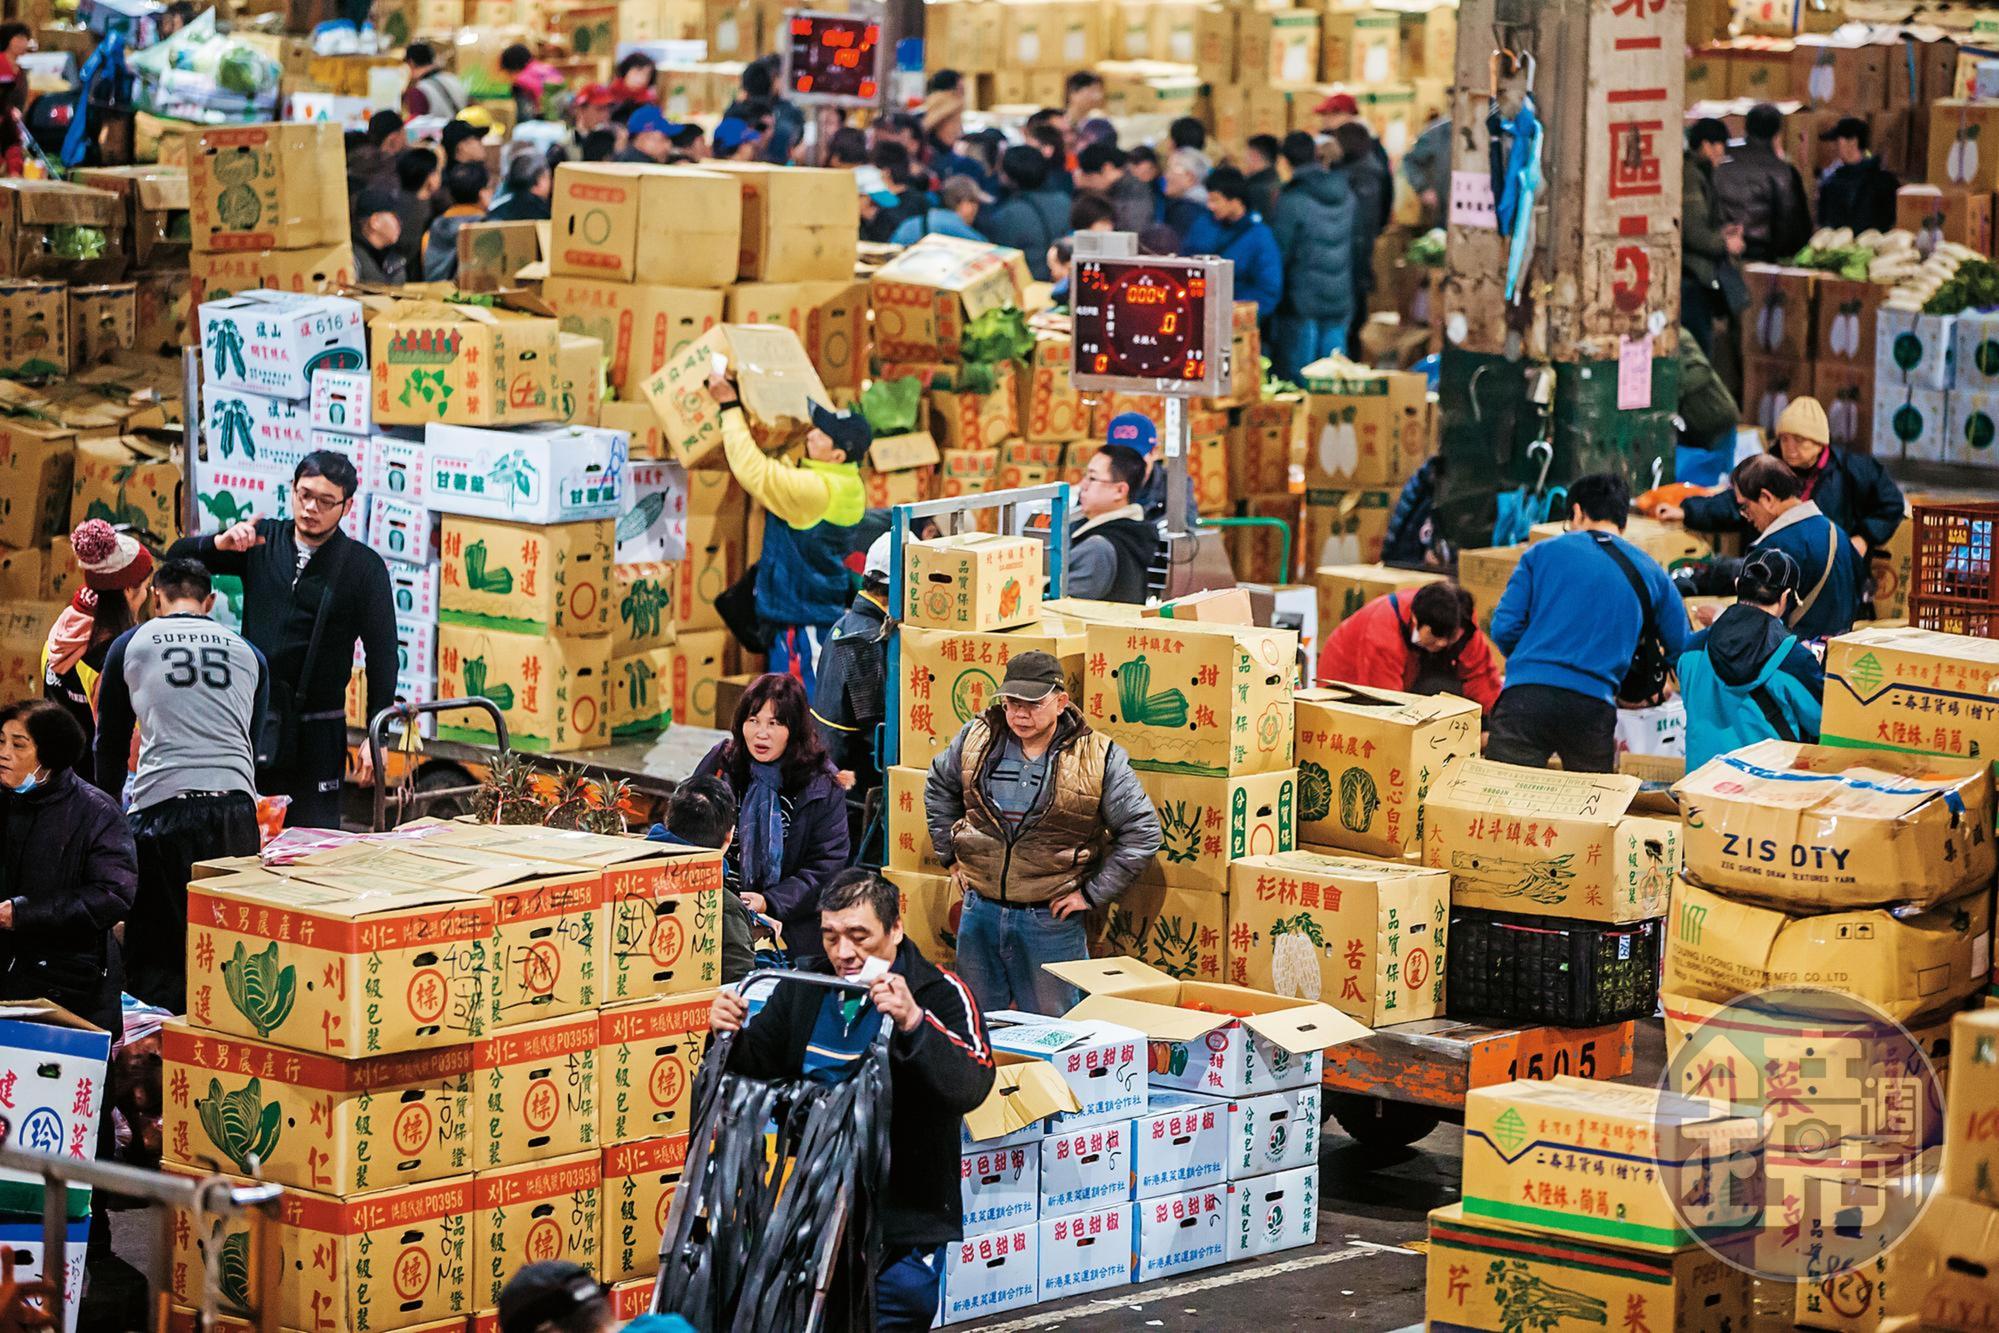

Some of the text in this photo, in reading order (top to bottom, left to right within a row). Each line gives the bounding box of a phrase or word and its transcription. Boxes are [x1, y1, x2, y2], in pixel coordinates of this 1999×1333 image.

[1126, 284, 1167, 304] 0004
[316, 315, 343, 336] 616
[443, 531, 462, 588] 甜椒
[520, 539, 541, 597] 特選
[908, 554, 922, 619] 分級包裝
[152, 633, 232, 647] SUPPORT
[160, 646, 233, 691] 35
[1127, 635, 1185, 655] 北斗鎮農會
[521, 655, 542, 713] 特選
[909, 664, 937, 736] 精緻
[1089, 652, 1108, 720] 特選
[1195, 664, 1220, 729] 甜椒
[1300, 730, 1376, 761] 田中鎮農會
[1203, 805, 1225, 860] 新鮮
[1386, 767, 1405, 845] 包心白菜
[1467, 817, 1559, 849] 北斗鎮農會
[1583, 843, 1605, 908] 芹菜
[1627, 834, 1640, 906] 分級包裝
[1721, 833, 1778, 863] ZIS
[614, 873, 647, 899] 刈仁
[1256, 874, 1343, 913] 杉林農會
[361, 924, 398, 947] 刈仁
[701, 889, 718, 982] 品質保證
[1198, 925, 1220, 978] 新鮮
[1230, 922, 1253, 988] 特選
[1432, 899, 1446, 1005] 分級包裝
[195, 932, 216, 1027] 特選
[1340, 938, 1367, 1004] 苦瓜
[321, 957, 346, 1051] 刈仁
[364, 952, 384, 1052] 分級包裝
[613, 1015, 646, 1041] 刈仁
[191, 1040, 302, 1083] 文男農產行
[485, 1039, 519, 1064] 刈仁
[1067, 1044, 1135, 1073] 彩色甜椒
[1208, 1053, 1225, 1089] 甜椒
[71, 1076, 94, 1162] 蔬菜
[170, 1068, 192, 1163] 特選
[488, 1066, 504, 1166] 分級包裝
[579, 1050, 595, 1144] 品質保證
[615, 1042, 630, 1139] 分級包裝
[307, 1094, 335, 1189] 刈仁
[355, 1089, 373, 1190] 分級包裝
[451, 1075, 469, 1169] 品質保證
[1056, 1129, 1120, 1161] 彩色甜椒
[1152, 1111, 1215, 1140] 彩色甜椒
[1242, 1105, 1255, 1169] 分級包裝
[616, 1149, 649, 1171] 刈仁
[352, 1205, 387, 1231] 刈仁
[488, 1178, 521, 1204] 刈仁
[1155, 1192, 1216, 1224] 彩色甜椒
[1240, 1187, 1252, 1250] 分級包裝
[620, 1175, 639, 1273] 分級包裝
[961, 1231, 1027, 1264] 彩色甜椒
[1054, 1211, 1120, 1242] 彩色甜椒
[310, 1238, 337, 1330] 刈仁
[355, 1232, 373, 1332] 分級包裝
[449, 1214, 466, 1312] 品質保證
[1447, 1263, 1651, 1333] 芹 菜
